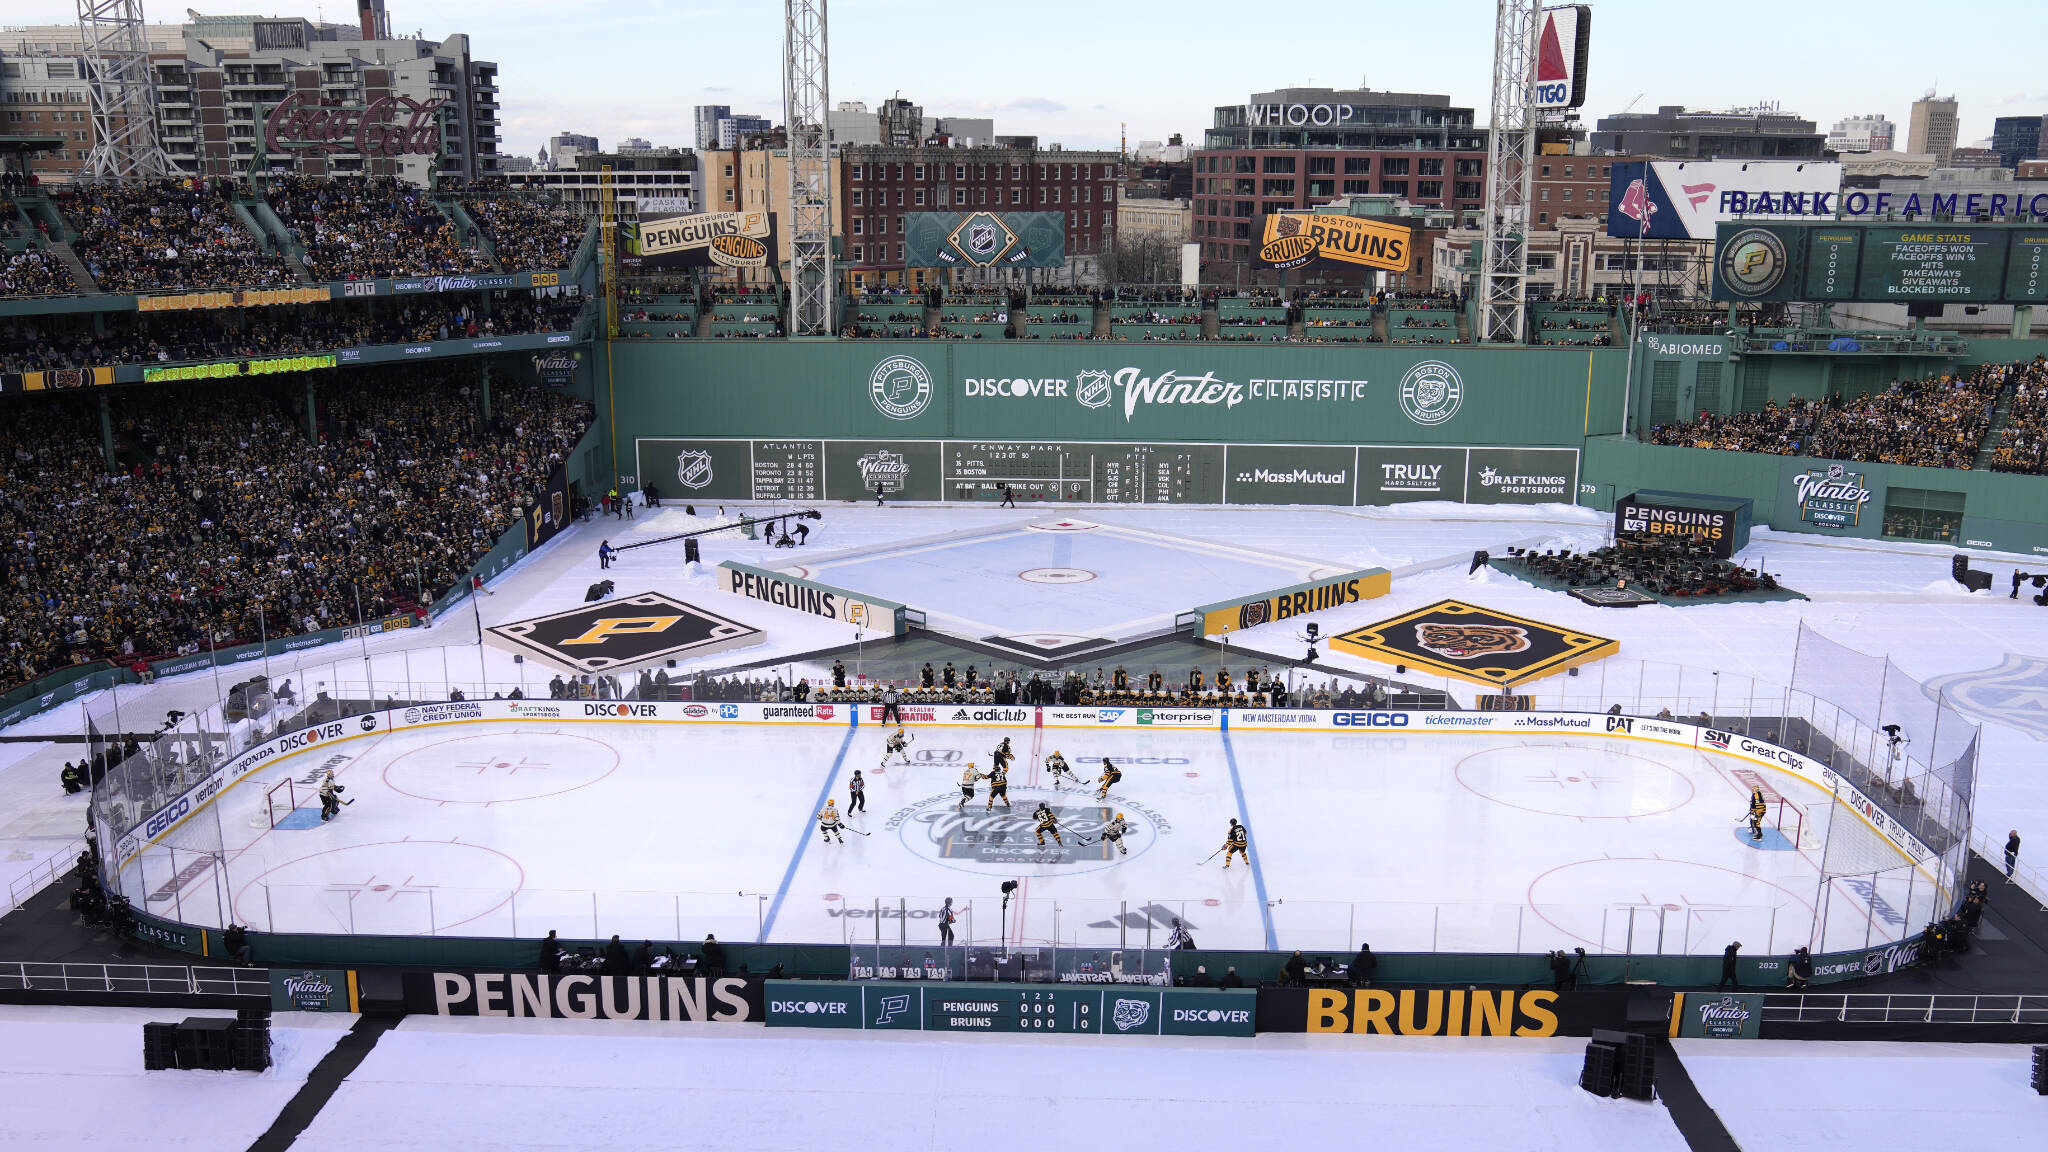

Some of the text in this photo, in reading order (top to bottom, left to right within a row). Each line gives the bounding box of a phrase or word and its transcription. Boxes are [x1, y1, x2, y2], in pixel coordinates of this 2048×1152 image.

[1244, 104, 1353, 126] WHOOP
[1731, 191, 1833, 214] BANK
[1847, 192, 1892, 215] OF
[679, 212, 735, 226] PITTSBURGH
[1312, 214, 1363, 230] BOSTON
[646, 219, 738, 248] PENGUINS
[974, 228, 991, 247] NHL
[1901, 234, 1971, 243] GAME STATS
[713, 236, 764, 258] PENGUINS
[1264, 237, 1312, 260] BRUINS
[1310, 224, 1404, 261] BRUINS
[1896, 245, 1973, 253] FACEOFFS WON
[713, 252, 762, 266] PITTSBURGH
[1275, 257, 1307, 269] BOSTON
[1891, 253, 1943, 261] FACEOFFS
[1945, 253, 1965, 261] WIN
[533, 275, 558, 285] BOS
[1902, 270, 1961, 278] TAKEAWAYS
[345, 284, 375, 294] PIT
[395, 282, 421, 290] DISCOVER
[434, 276, 478, 292] Winter
[1902, 278, 1959, 286] GIVEAWAYS
[1888, 286, 1971, 294] BLOCKED SHOTS
[405, 346, 431, 354] DISCOVER
[1659, 344, 1722, 354] ABIOMED
[532, 355, 579, 377] Winter
[878, 362, 925, 381] PITTSBURGH
[1414, 367, 1451, 379] BOSTON
[965, 367, 1367, 423] DISCOVER NHL Winter CLASSIC
[880, 400, 922, 414] PENGUINS
[1414, 408, 1447, 419] BRUINS
[686, 462, 706, 480] NHL
[857, 457, 909, 481] Winter
[1381, 464, 1442, 479] TRULY
[621, 476, 635, 484] 310
[1254, 469, 1345, 484] MassMutual
[1480, 475, 1566, 486] DRAFTKINGS
[1500, 486, 1564, 494] SPORTSBOOK
[1580, 485, 1596, 494] 379
[1793, 474, 1871, 508] Winter
[1808, 500, 1855, 511] CLASSIC
[1625, 506, 1724, 527] PENGUINS
[1814, 512, 1845, 521] DISCOVER
[1627, 521, 1722, 539] VS BRUINS
[731, 569, 836, 619] PENGUINS
[1277, 579, 1360, 621] BRUINS
[343, 618, 409, 639] PIT BOS
[285, 638, 321, 649] ticketmaster
[235, 650, 265, 659] verizon
[421, 702, 481, 713] NAVY FEDERAL
[585, 703, 657, 717] DISCOVER
[721, 704, 738, 718] PPG
[763, 705, 834, 720] guaranteed Rate
[422, 711, 482, 722] CREDIT UNION
[973, 708, 1027, 722] adiclub
[1100, 712, 1119, 721] SAP
[1141, 713, 1212, 722] enterprise
[1242, 714, 1316, 723] NEW AMSTERDAM VODKA
[1333, 713, 1408, 727] GEICO
[1425, 715, 1494, 726] ticketmaster
[360, 719, 376, 728] TNT
[1527, 717, 1591, 728] MassMutual
[1606, 716, 1634, 733] CAT
[280, 723, 344, 753] DISCOVER
[1704, 730, 1732, 744] SN
[237, 747, 276, 770] HONDA
[1741, 739, 1803, 770] Great Clips
[195, 778, 224, 804] verizon
[824, 810, 836, 820] 44
[1850, 789, 1885, 829] DISCOVER
[146, 797, 190, 839] GEICO
[1038, 812, 1048, 823] 63
[1889, 819, 1906, 840] TRULY
[981, 845, 1071, 855] DISCOVER
[1908, 835, 1926, 856] TRULY
[138, 921, 187, 945] CLASSIC
[1814, 961, 1860, 977] DISCOVER
[284, 978, 333, 999] Winter
[433, 972, 750, 1022] PENGUINS
[771, 1001, 848, 1014] DISCOVER
[943, 1002, 998, 1012] PENGUINS
[1306, 988, 1560, 1037] BRUINS
[1174, 1009, 1249, 1023] DISCOVER
[1700, 1004, 1750, 1025] Winter
[950, 1017, 992, 1027] BRUINS
